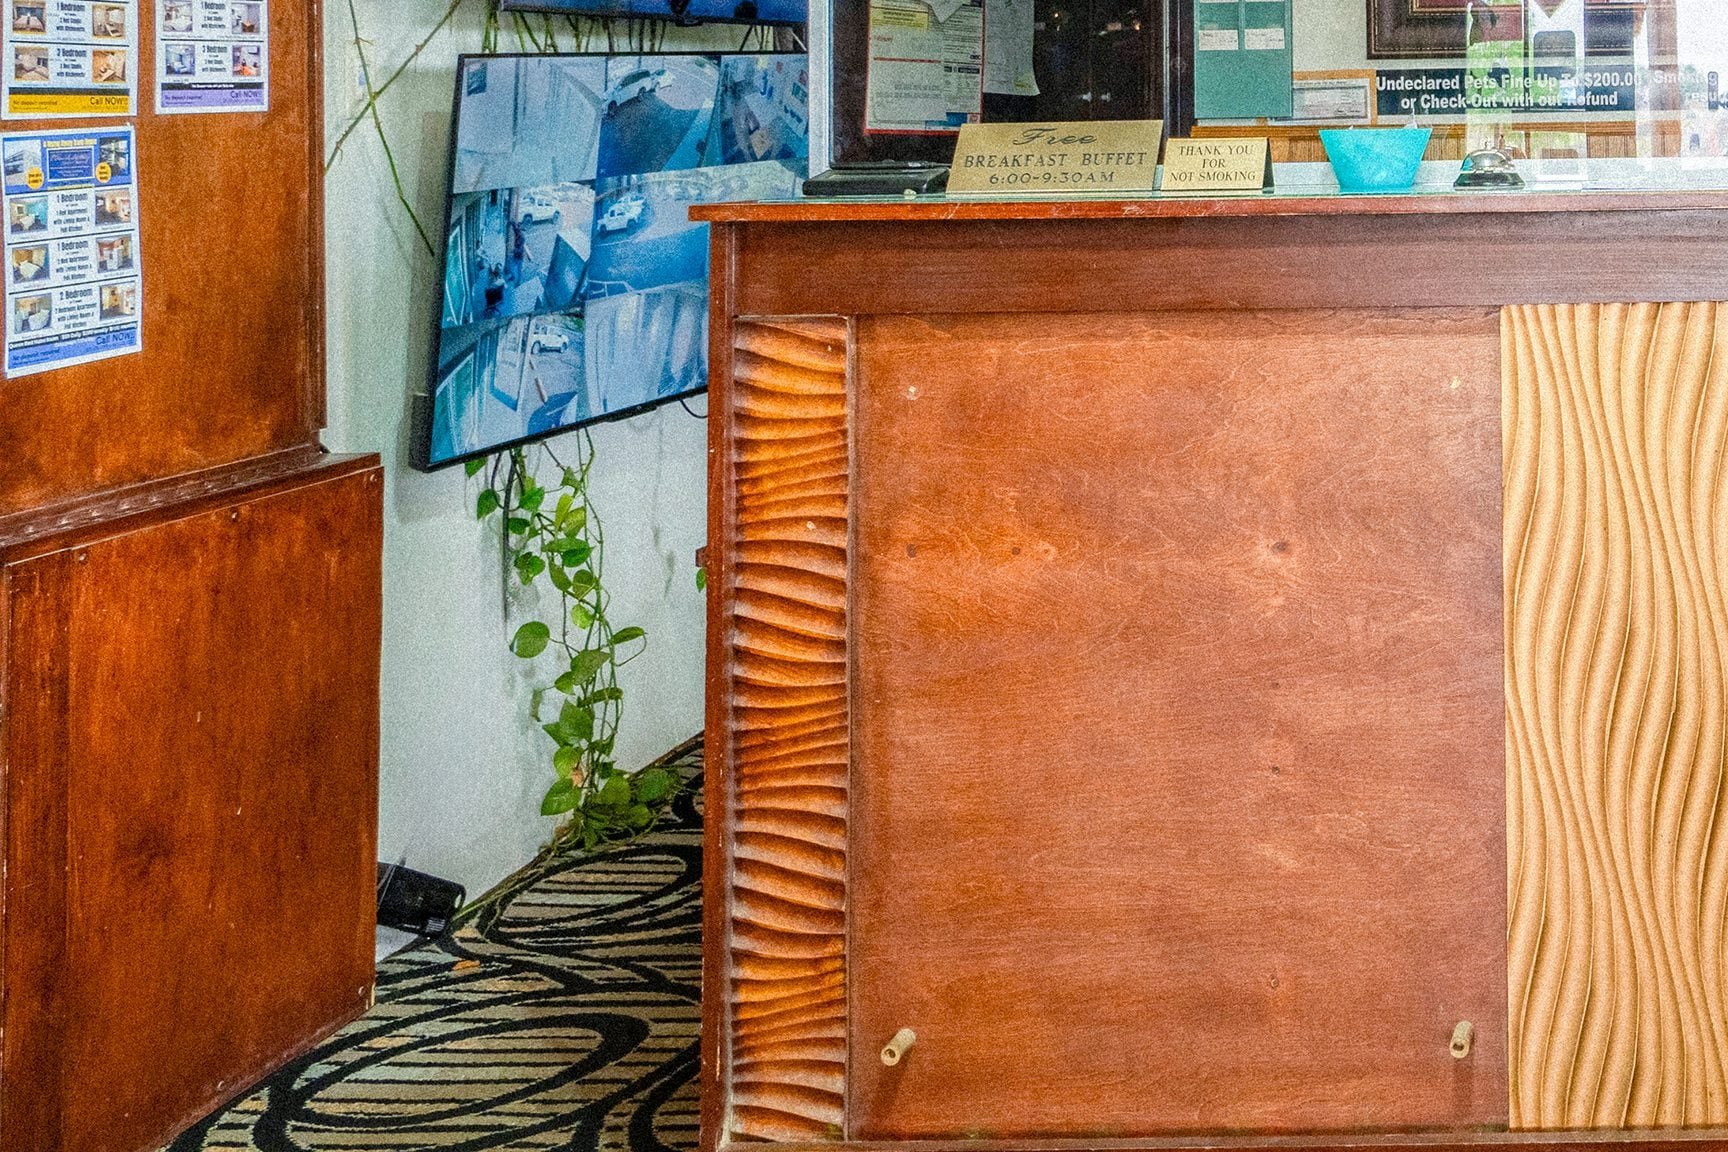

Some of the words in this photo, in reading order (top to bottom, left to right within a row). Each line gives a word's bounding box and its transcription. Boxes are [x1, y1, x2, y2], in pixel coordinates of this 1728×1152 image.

[1376, 75, 1460, 91] Undeclared
[1465, 75, 1497, 89] Pets
[1501, 74, 1532, 88] Fine
[1537, 74, 1557, 92] Up
[1584, 72, 1642, 89] $200.00
[1401, 97, 1416, 109] or
[1421, 94, 1497, 109] Check-Out
[1501, 93, 1534, 107] with
[1538, 94, 1562, 107] out
[1567, 91, 1618, 106] Refund
[1012, 127, 1098, 146] Free
[1179, 145, 1222, 156] THANK
[1227, 144, 1255, 156] YOU
[963, 152, 1068, 169] BREAKFAST
[1080, 151, 1149, 167] BUFFET
[1201, 158, 1227, 169] FOR
[1169, 171, 1195, 183] NOT
[1198, 170, 1257, 182] SMOKING
[61, 192, 88, 203] Bedroom
